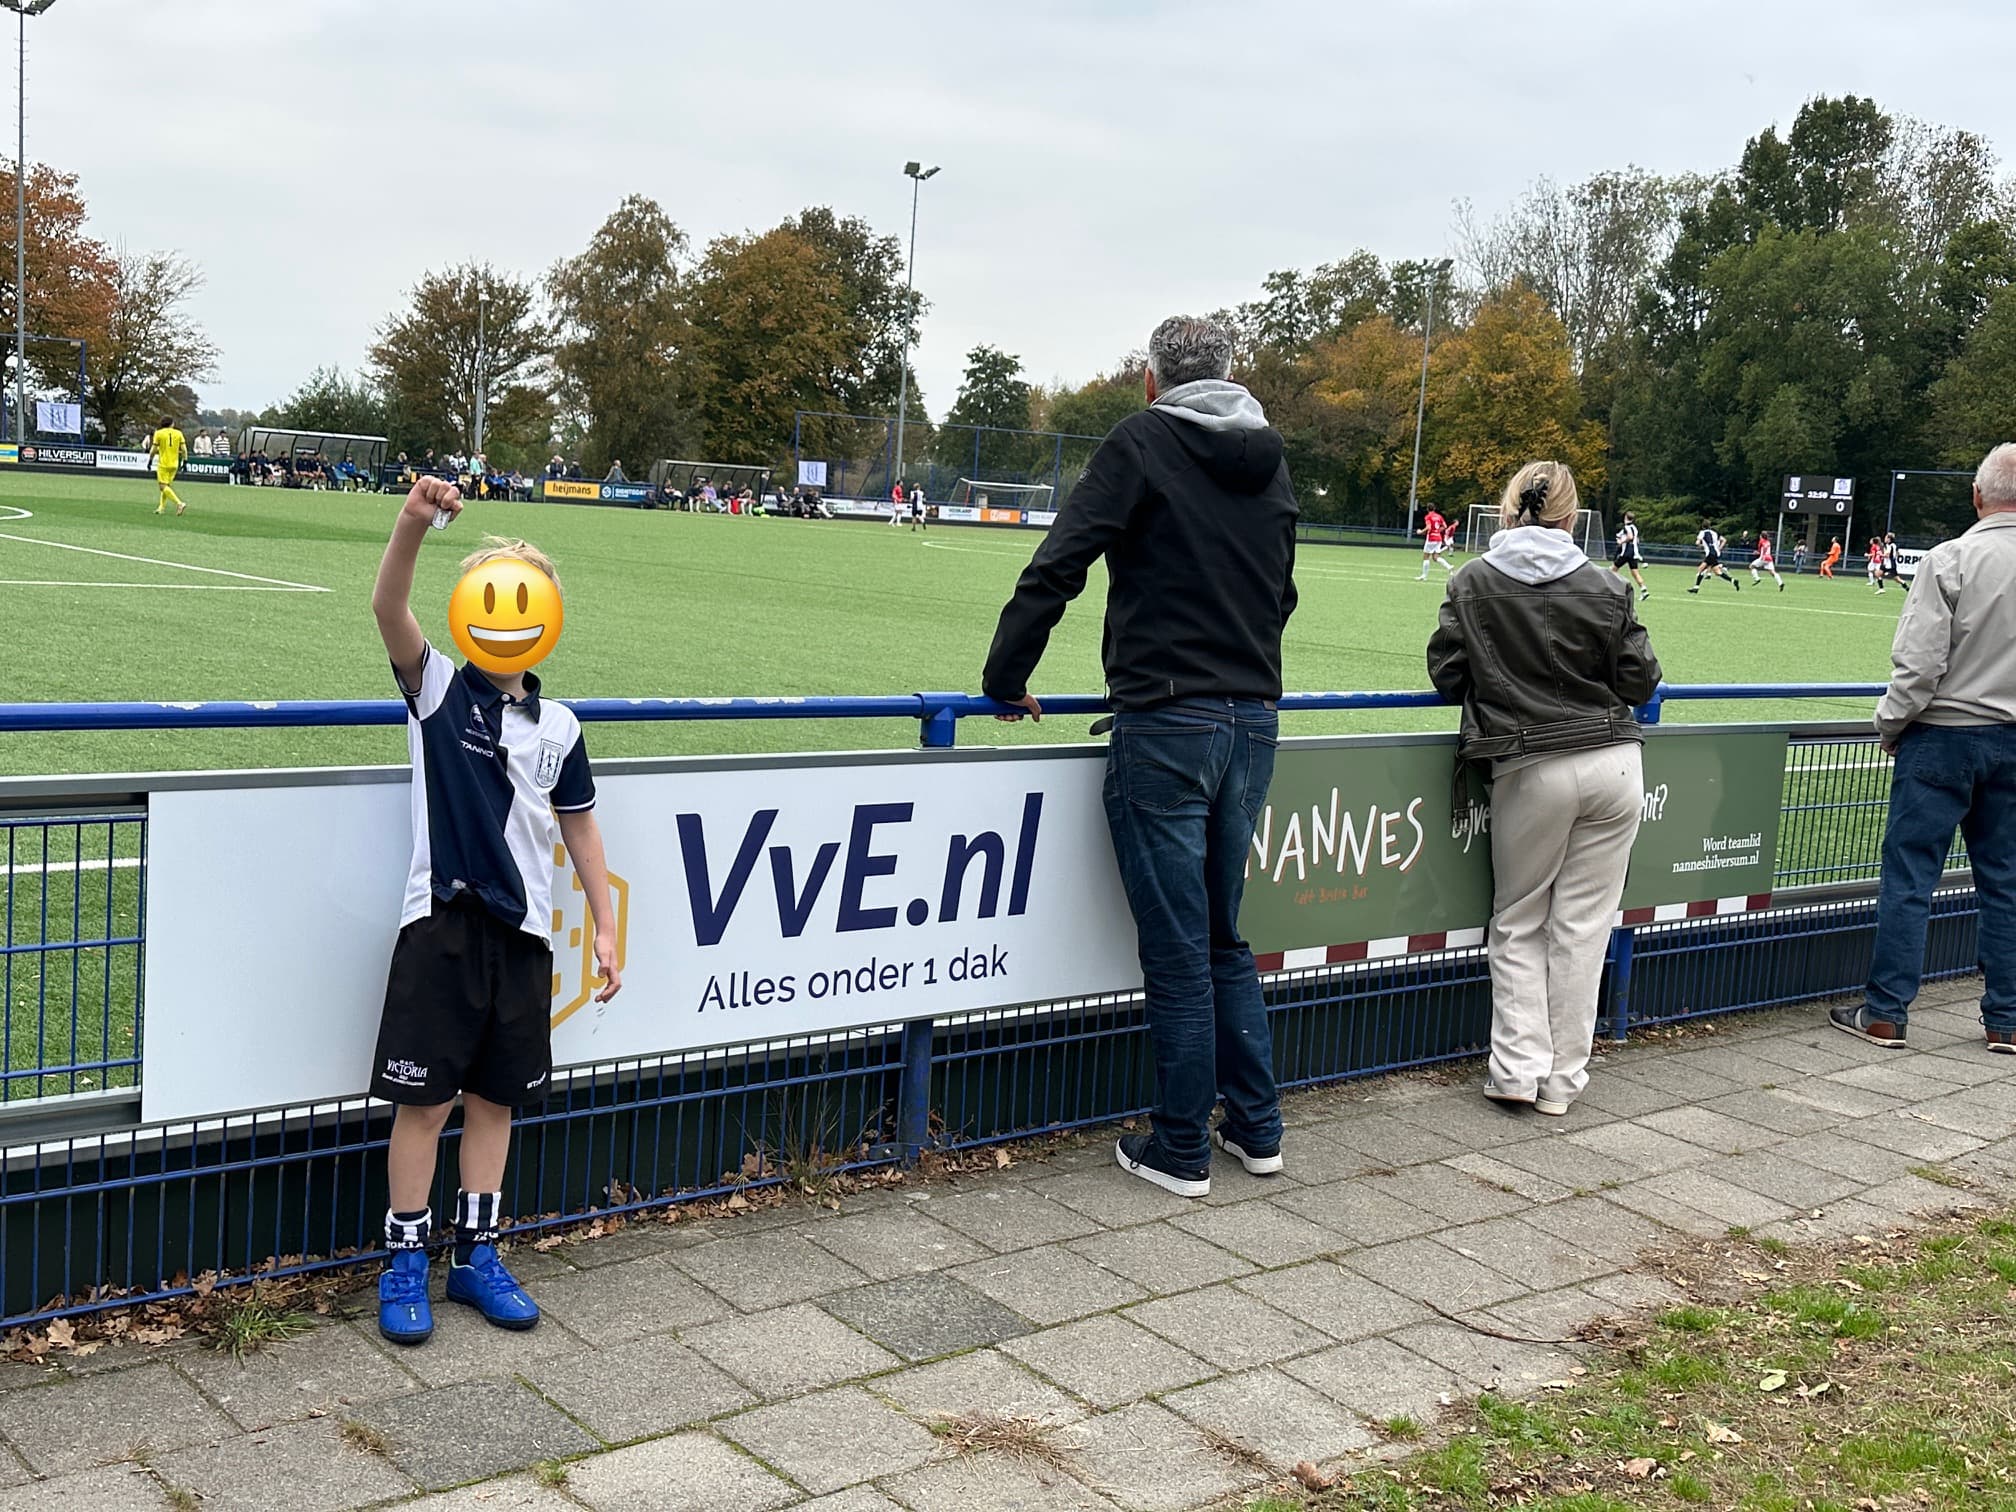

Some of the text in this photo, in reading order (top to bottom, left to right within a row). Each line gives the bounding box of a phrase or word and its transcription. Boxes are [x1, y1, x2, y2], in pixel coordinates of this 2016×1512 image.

[38, 449, 95, 461] HILVERSUM
[552, 482, 592, 495] heijmans
[1788, 499, 1844, 512] 0 0
[1896, 555, 1923, 565] ORP
[1640, 783, 1668, 822] nt?
[1244, 787, 1424, 883] NANNES
[1702, 832, 1762, 852] Word teamlid
[675, 792, 1044, 946] VvE.nl
[1672, 850, 1760, 873] nanneshilversum.nl
[698, 943, 1009, 1013] Alles onder 1 dak
[387, 1058, 429, 1078] VICTORIA
